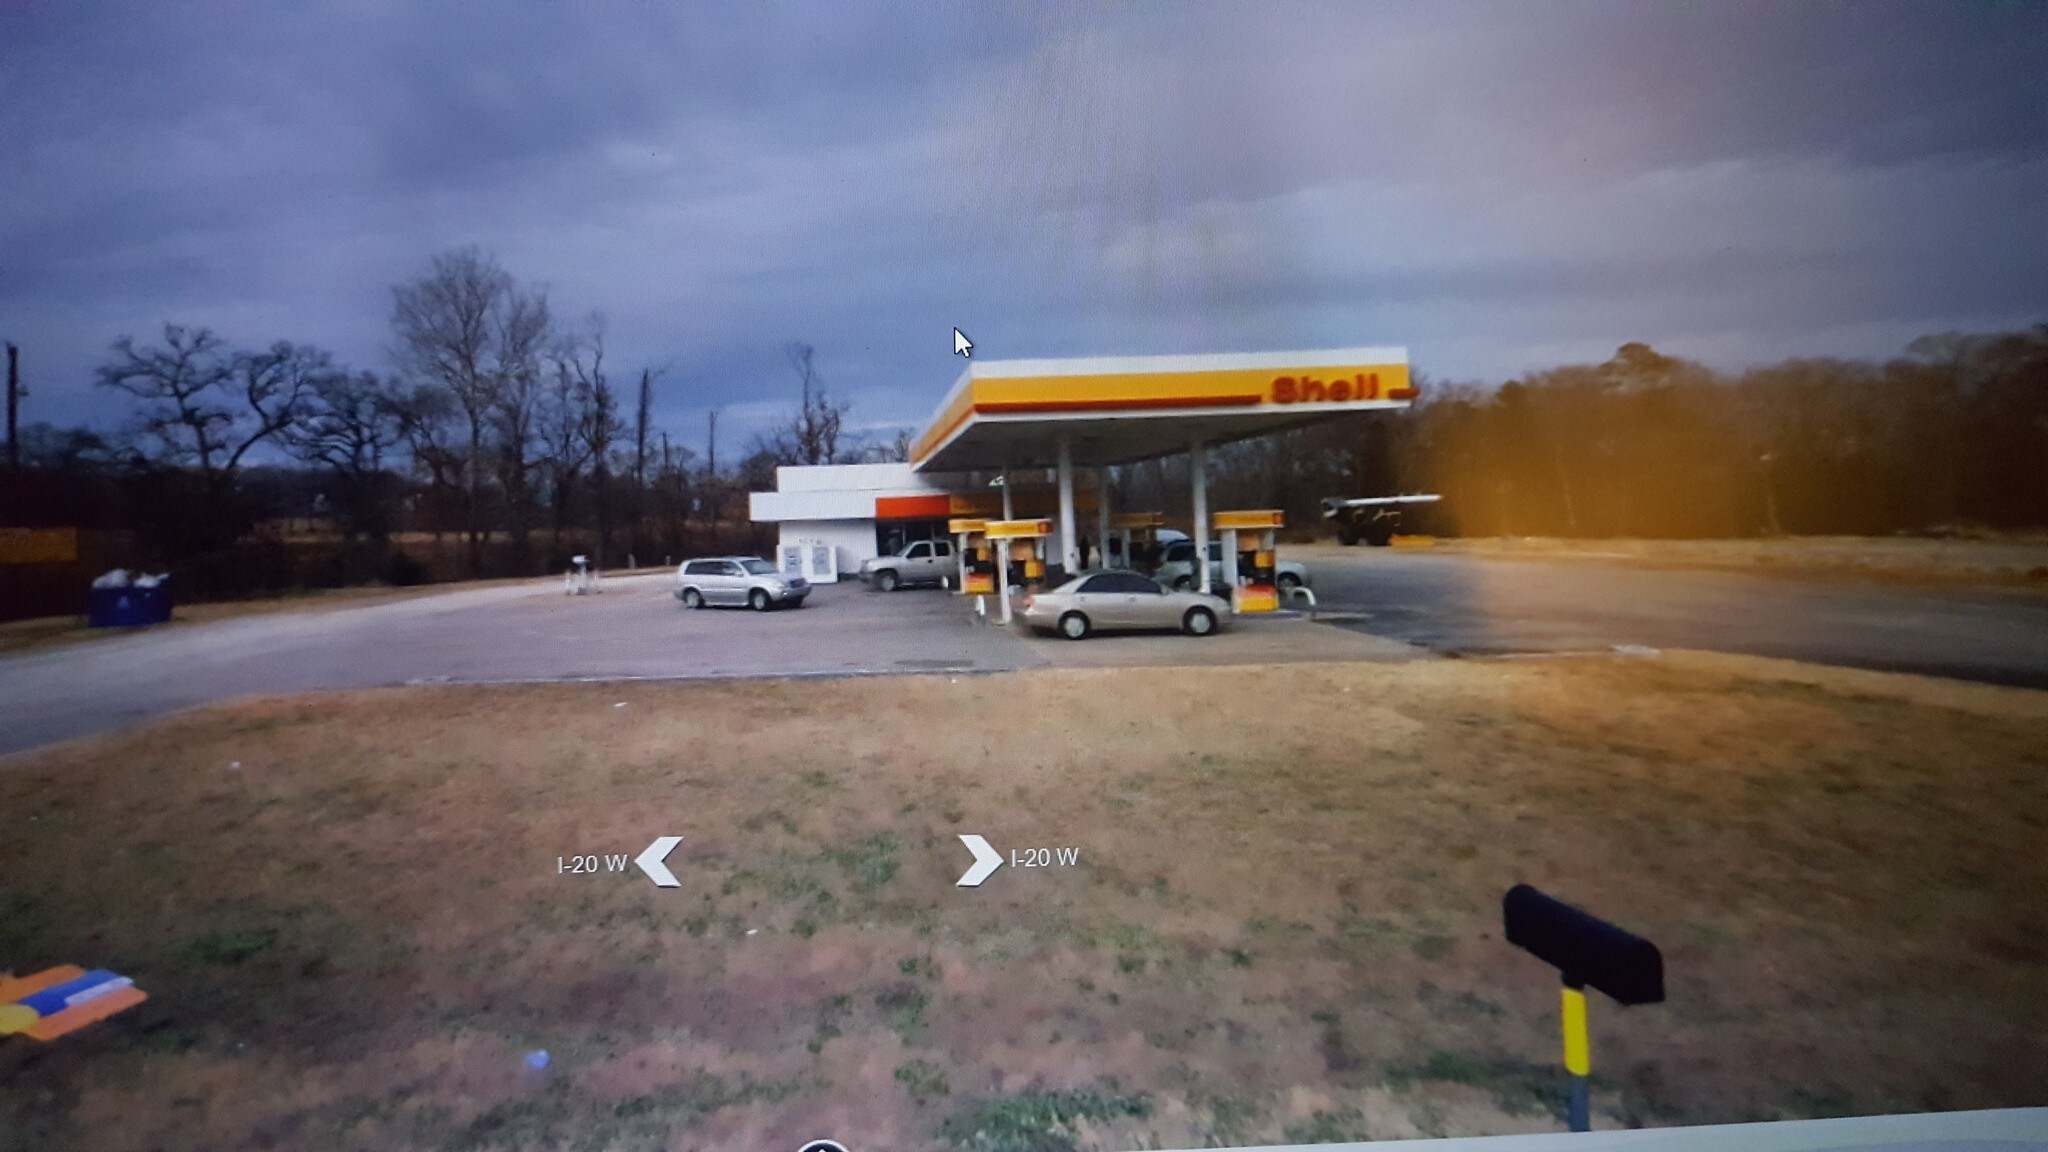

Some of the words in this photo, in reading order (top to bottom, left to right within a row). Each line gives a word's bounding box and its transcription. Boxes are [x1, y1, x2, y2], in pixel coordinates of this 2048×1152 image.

[1272, 373, 1379, 404] Shell
[557, 855, 598, 874] I-20
[604, 854, 628, 872] W
[1011, 848, 1051, 868] I-20
[1056, 847, 1079, 866] W
